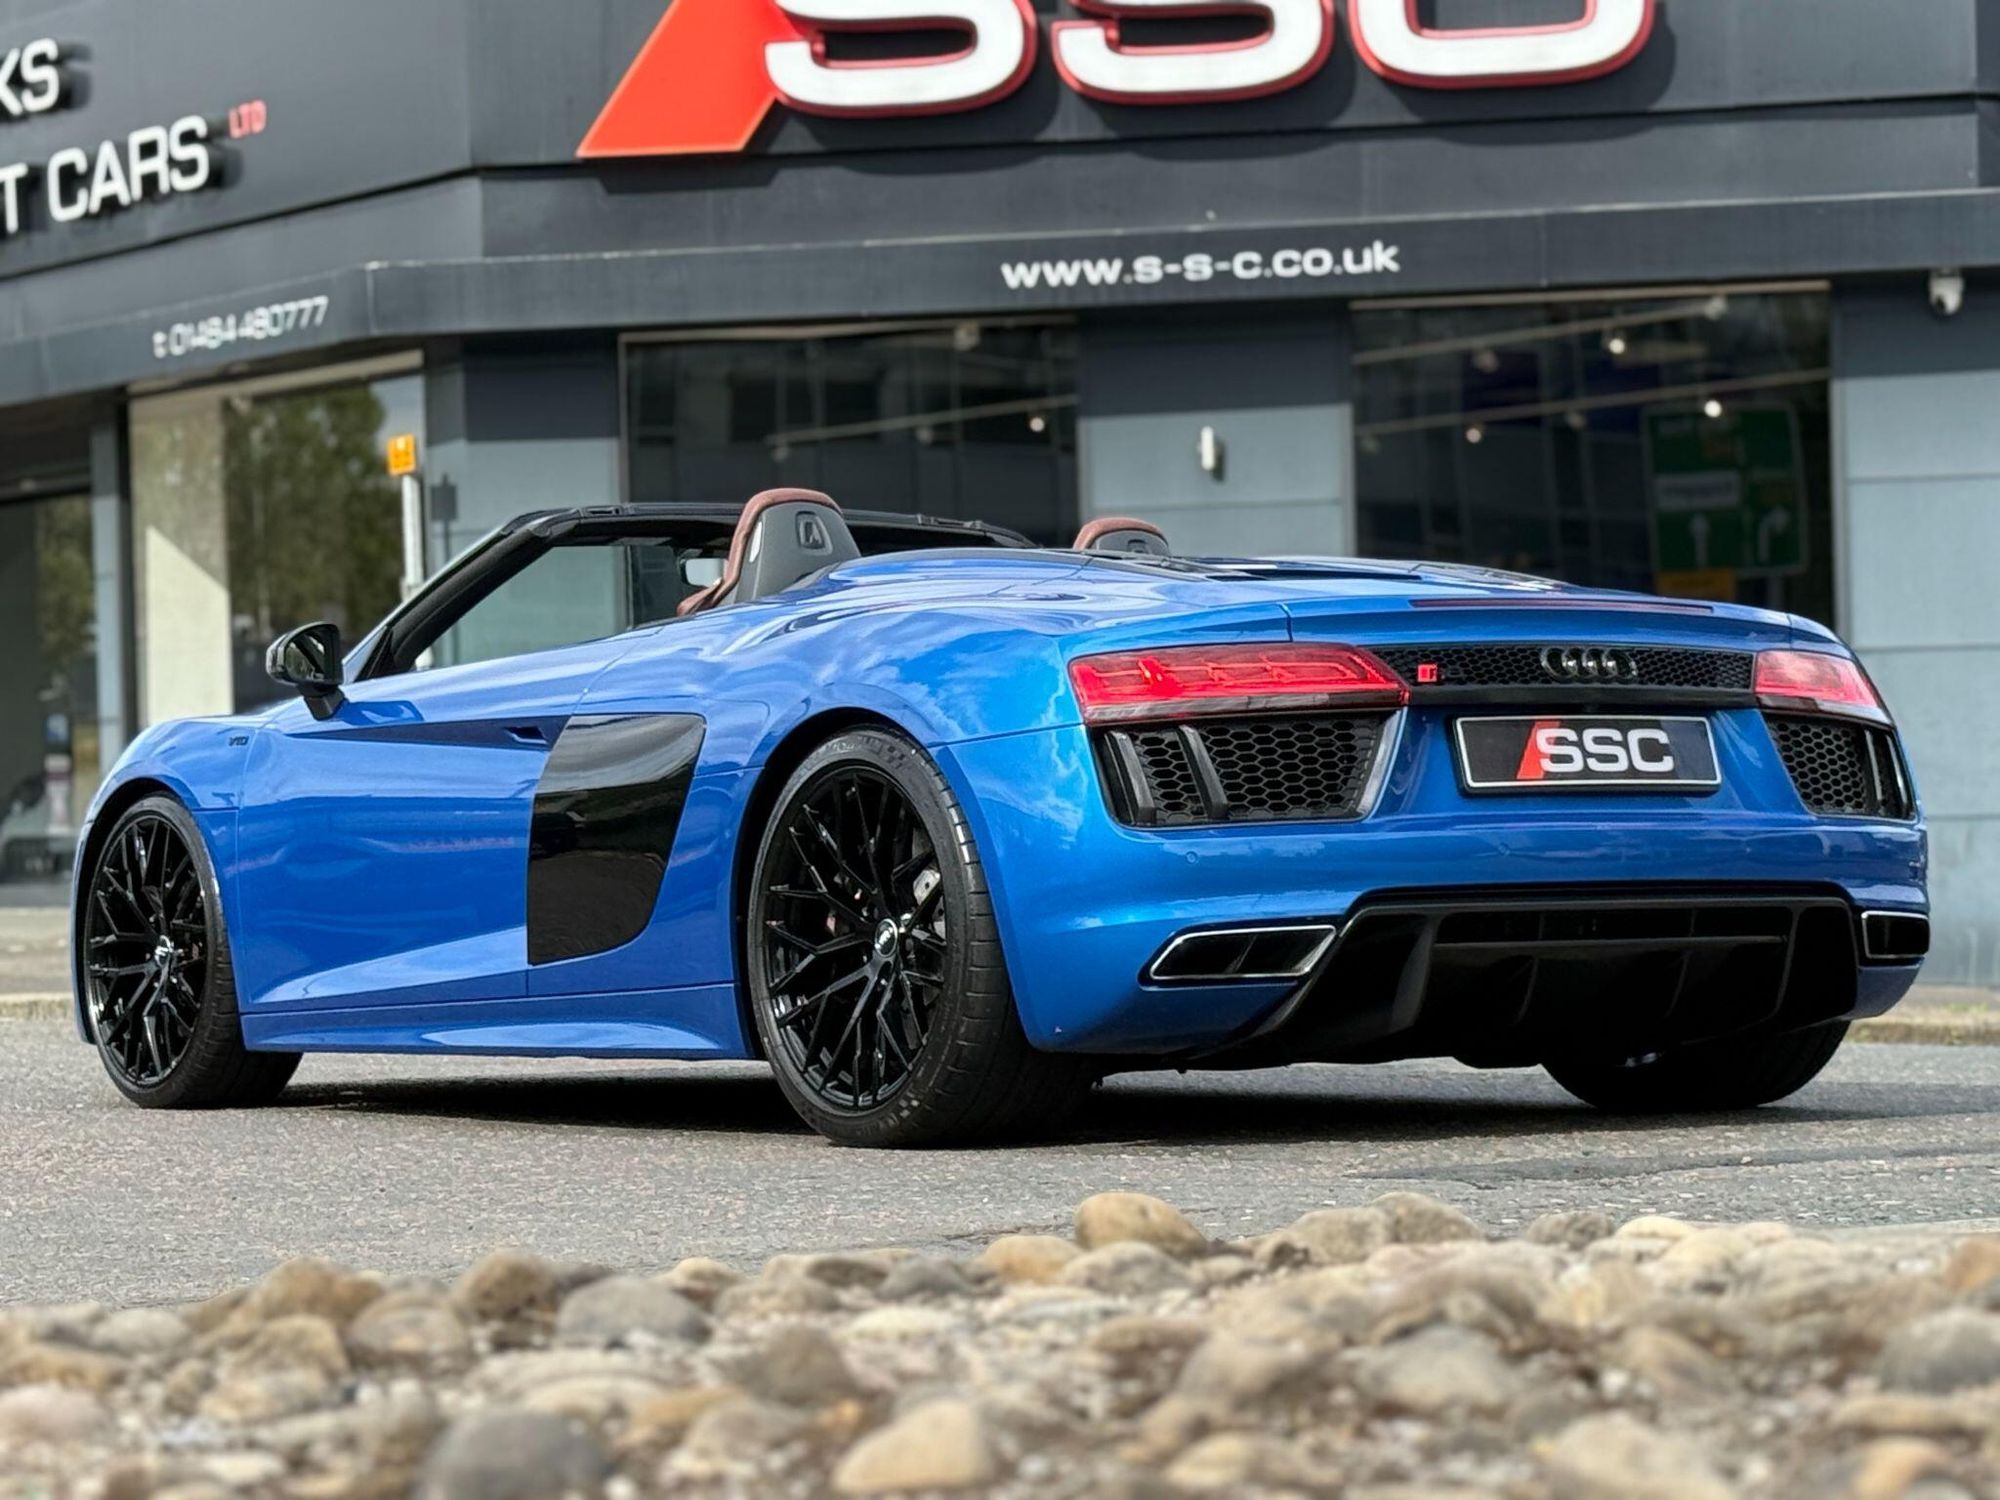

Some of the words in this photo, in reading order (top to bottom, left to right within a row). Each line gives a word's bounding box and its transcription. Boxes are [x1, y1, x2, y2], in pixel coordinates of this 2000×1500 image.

[47, 115, 210, 222] CARS
[228, 100, 267, 139] LTD
[1000, 239, 1401, 289] www.s-s-c.co.uk
[1536, 728, 1675, 773] SSC
